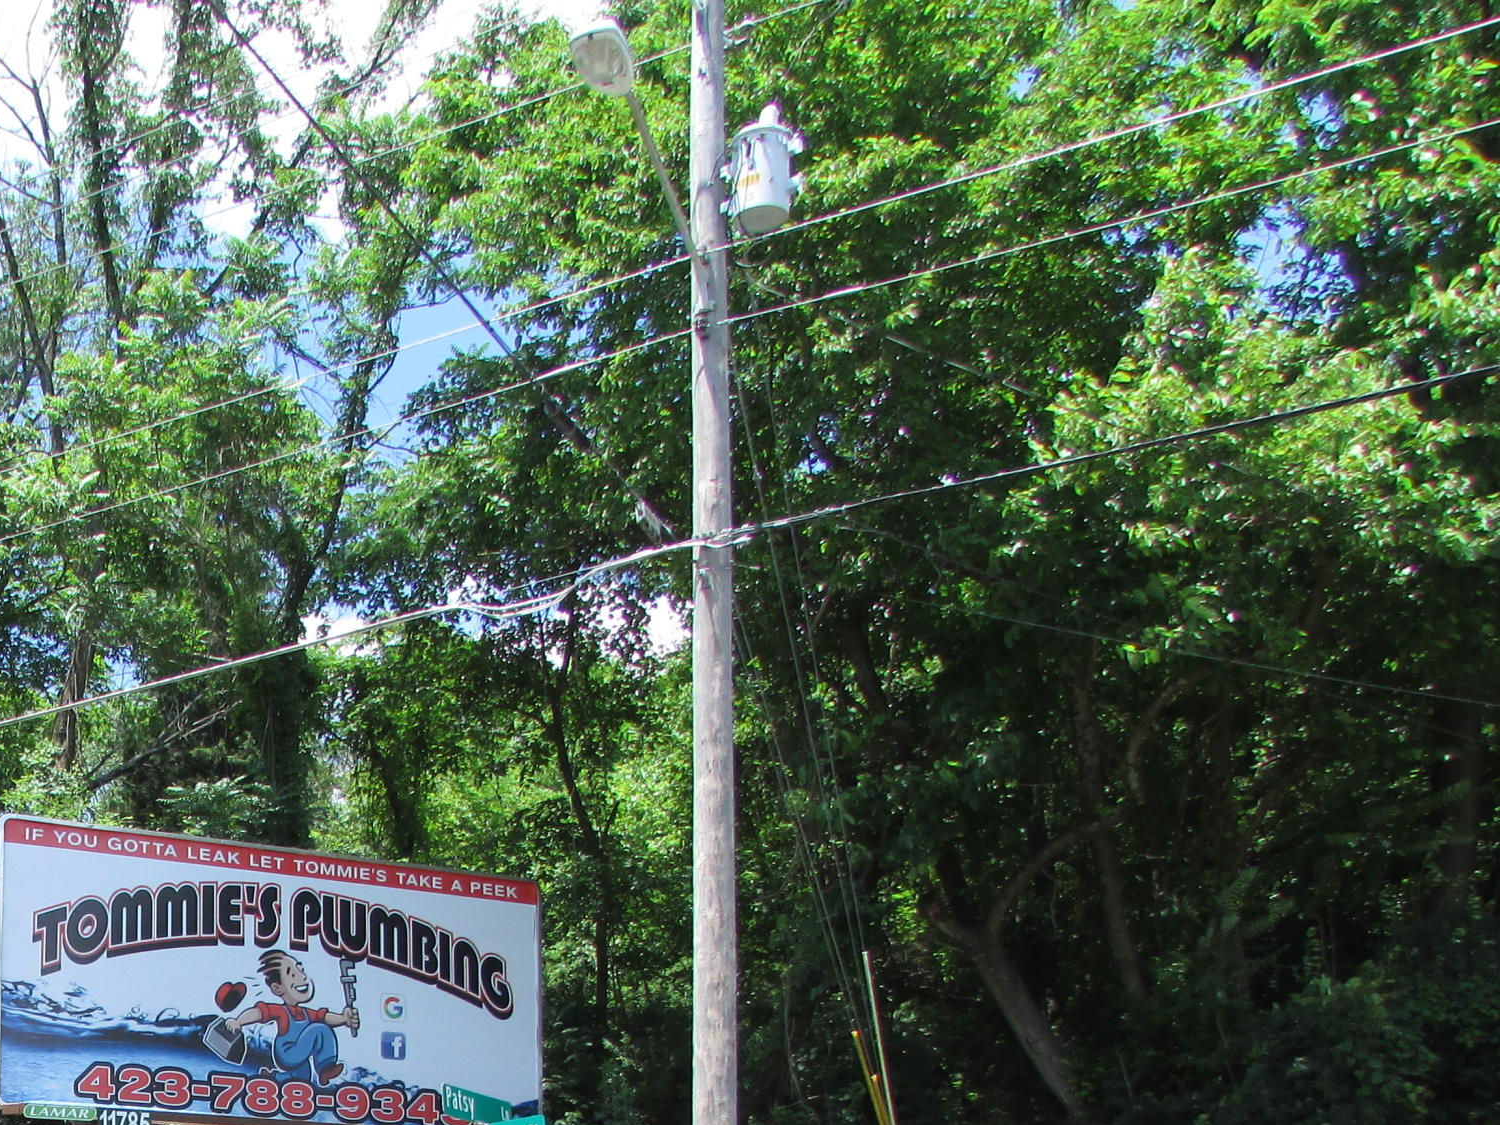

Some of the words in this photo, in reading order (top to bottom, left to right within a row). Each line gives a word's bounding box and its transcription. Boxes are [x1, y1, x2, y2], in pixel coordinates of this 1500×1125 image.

[24, 827, 44, 841] IF
[53, 830, 98, 848] YOU
[107, 837, 178, 858] GOTTA
[187, 846, 240, 865] LEAK
[250, 853, 285, 870] LET
[293, 859, 388, 883] TOMMIE'S
[396, 872, 443, 890] TAKE
[451, 880, 463, 892] A
[470, 881, 518, 899] PEEK
[33, 880, 281, 975] TOMMIE'S
[289, 887, 514, 1020] PLUMBING
[29, 1105, 91, 1119] LAMAR
[445, 1085, 475, 1121] Patsy
